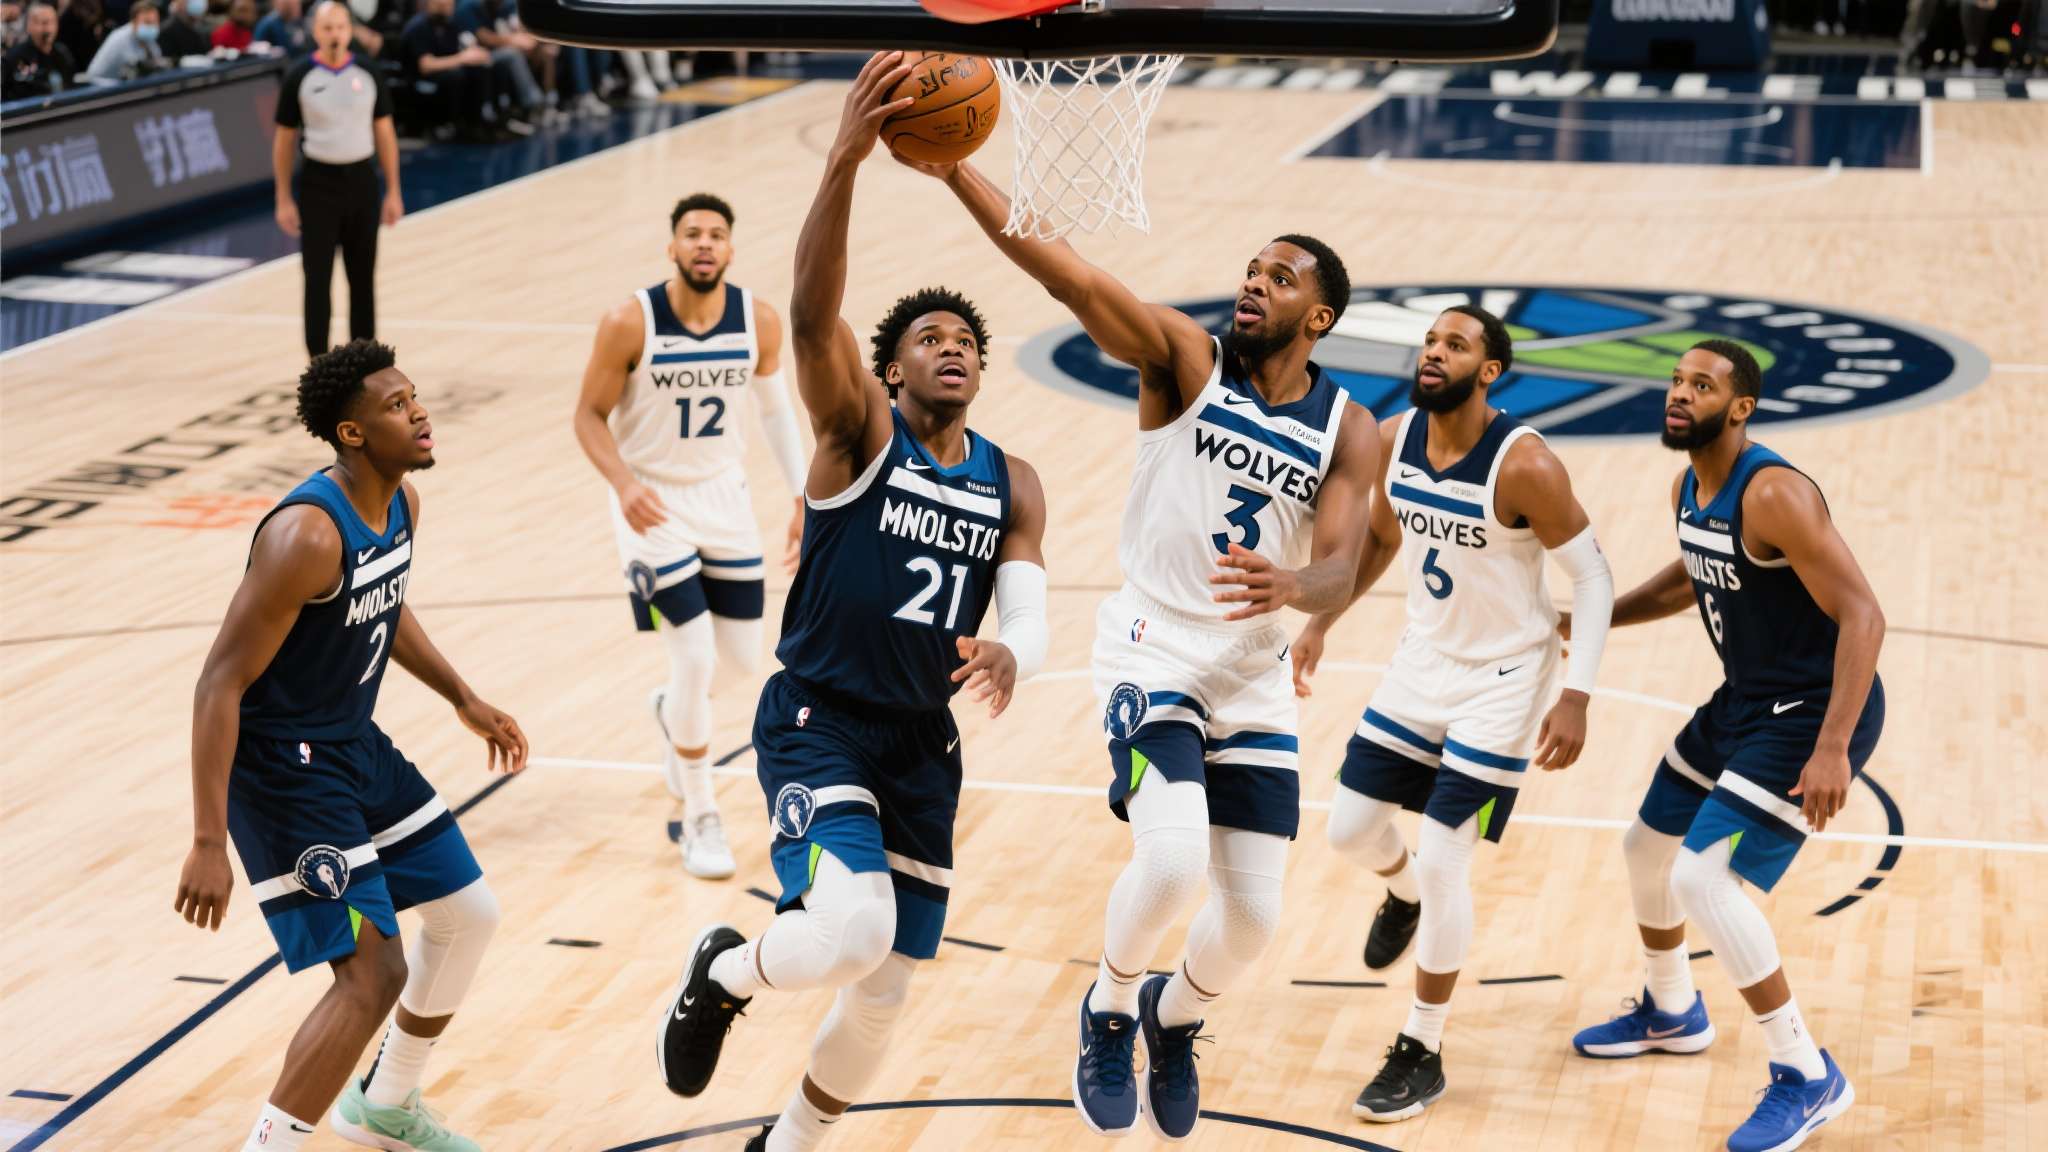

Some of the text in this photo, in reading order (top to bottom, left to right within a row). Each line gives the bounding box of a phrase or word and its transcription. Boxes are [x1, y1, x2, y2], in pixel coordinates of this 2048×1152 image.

[651, 368, 748, 390] WOLVES
[675, 396, 726, 438] 12
[1195, 427, 1319, 501] WOLVES
[1212, 484, 1273, 556] 3
[1392, 504, 1487, 549] WOLVES
[892, 556, 969, 629] 21
[1422, 547, 1453, 600] 6
[358, 621, 388, 686] 2
